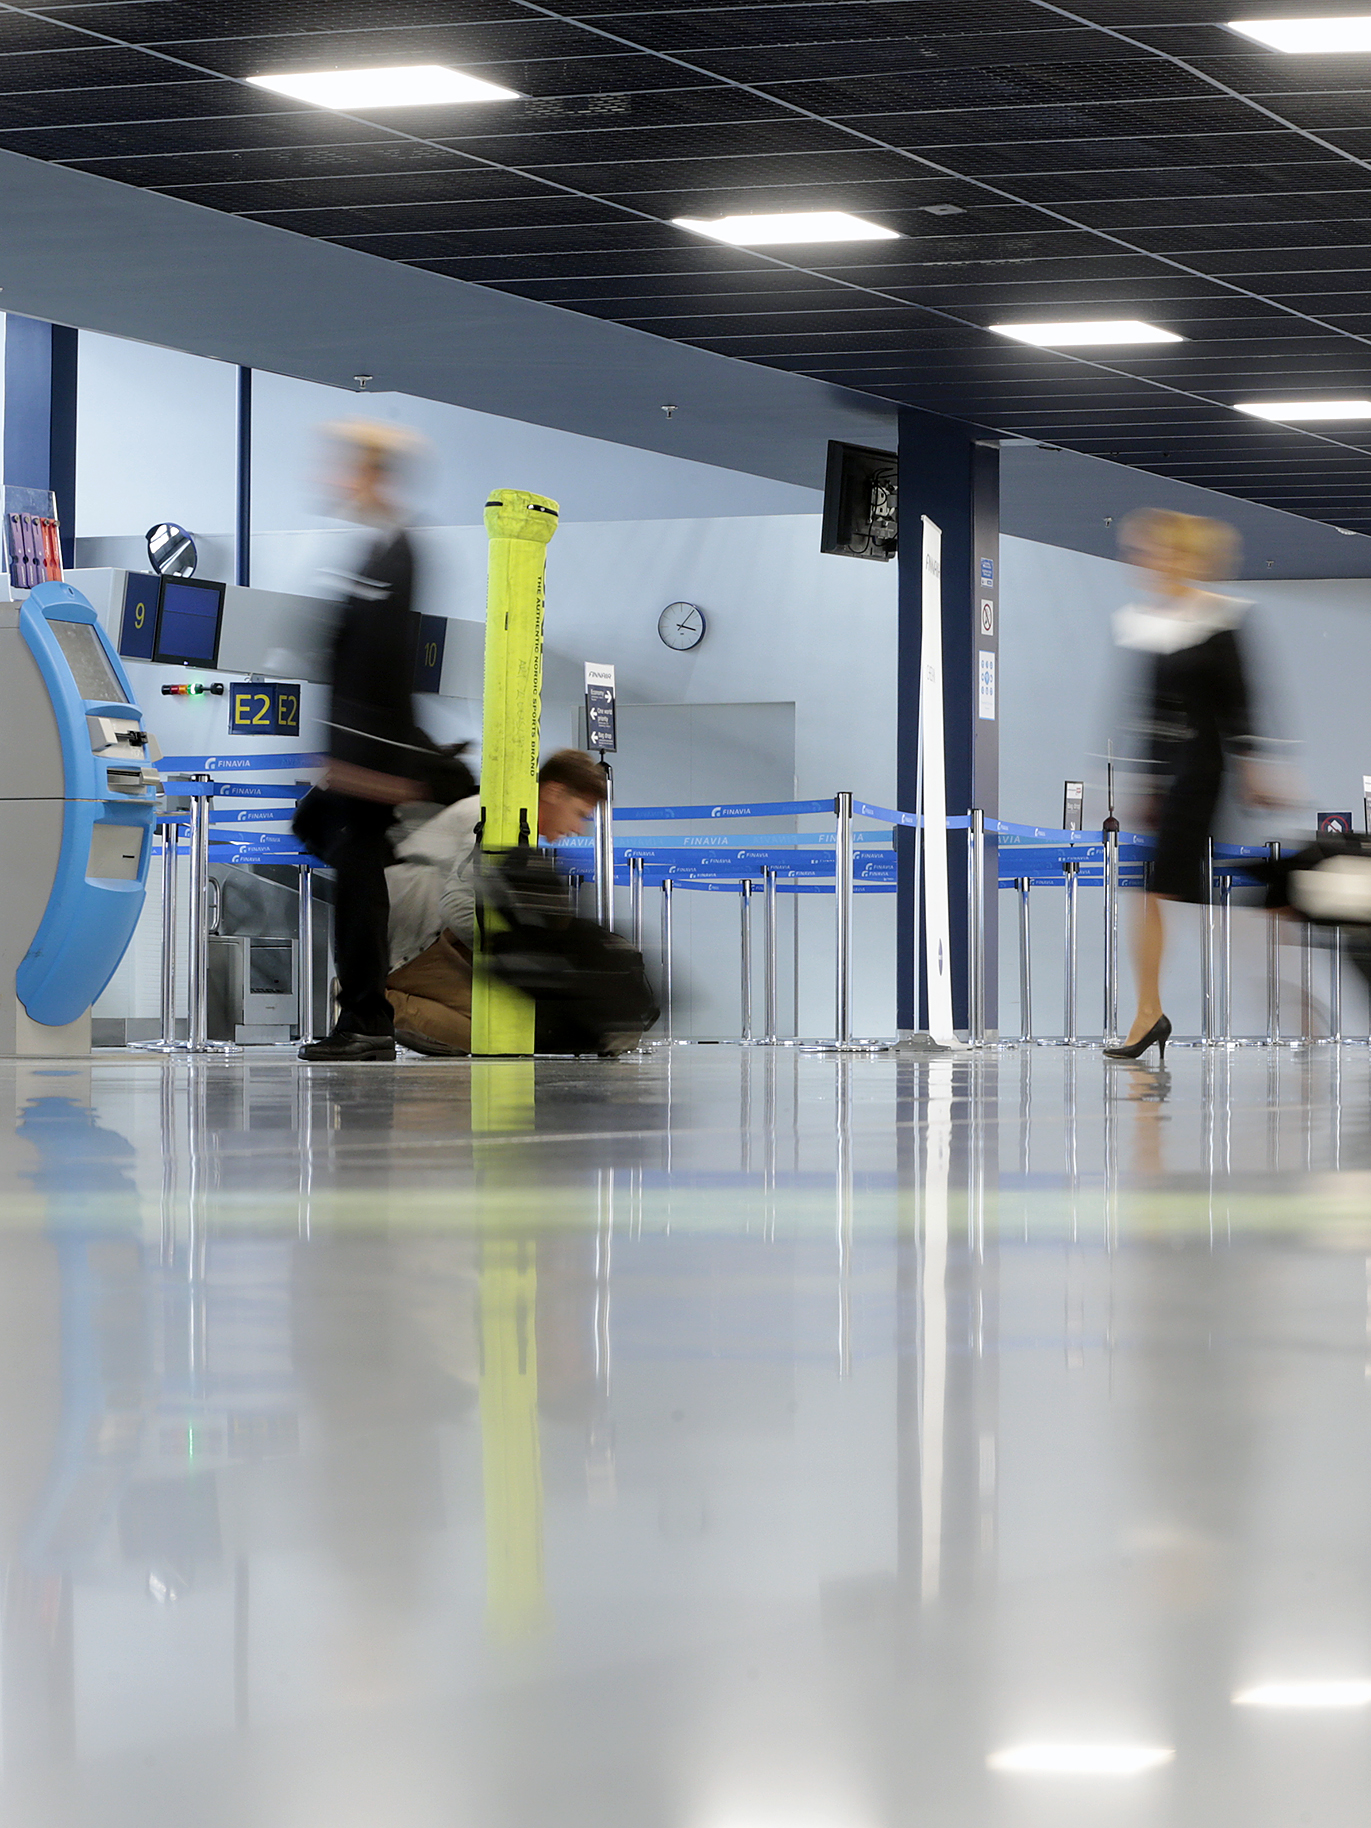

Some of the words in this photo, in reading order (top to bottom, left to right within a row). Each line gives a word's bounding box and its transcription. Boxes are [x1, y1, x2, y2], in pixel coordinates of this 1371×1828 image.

[134, 602, 146, 629] 9
[424, 642, 438, 667] 10
[588, 671, 612, 680] FINNAIR
[235, 694, 271, 725] E2
[278, 694, 298, 726] E2
[218, 760, 251, 768] FINAVIA
[248, 812, 274, 820] FINAVIA
[722, 808, 751, 816] FINAVIA
[683, 837, 729, 846] FINAVIA
